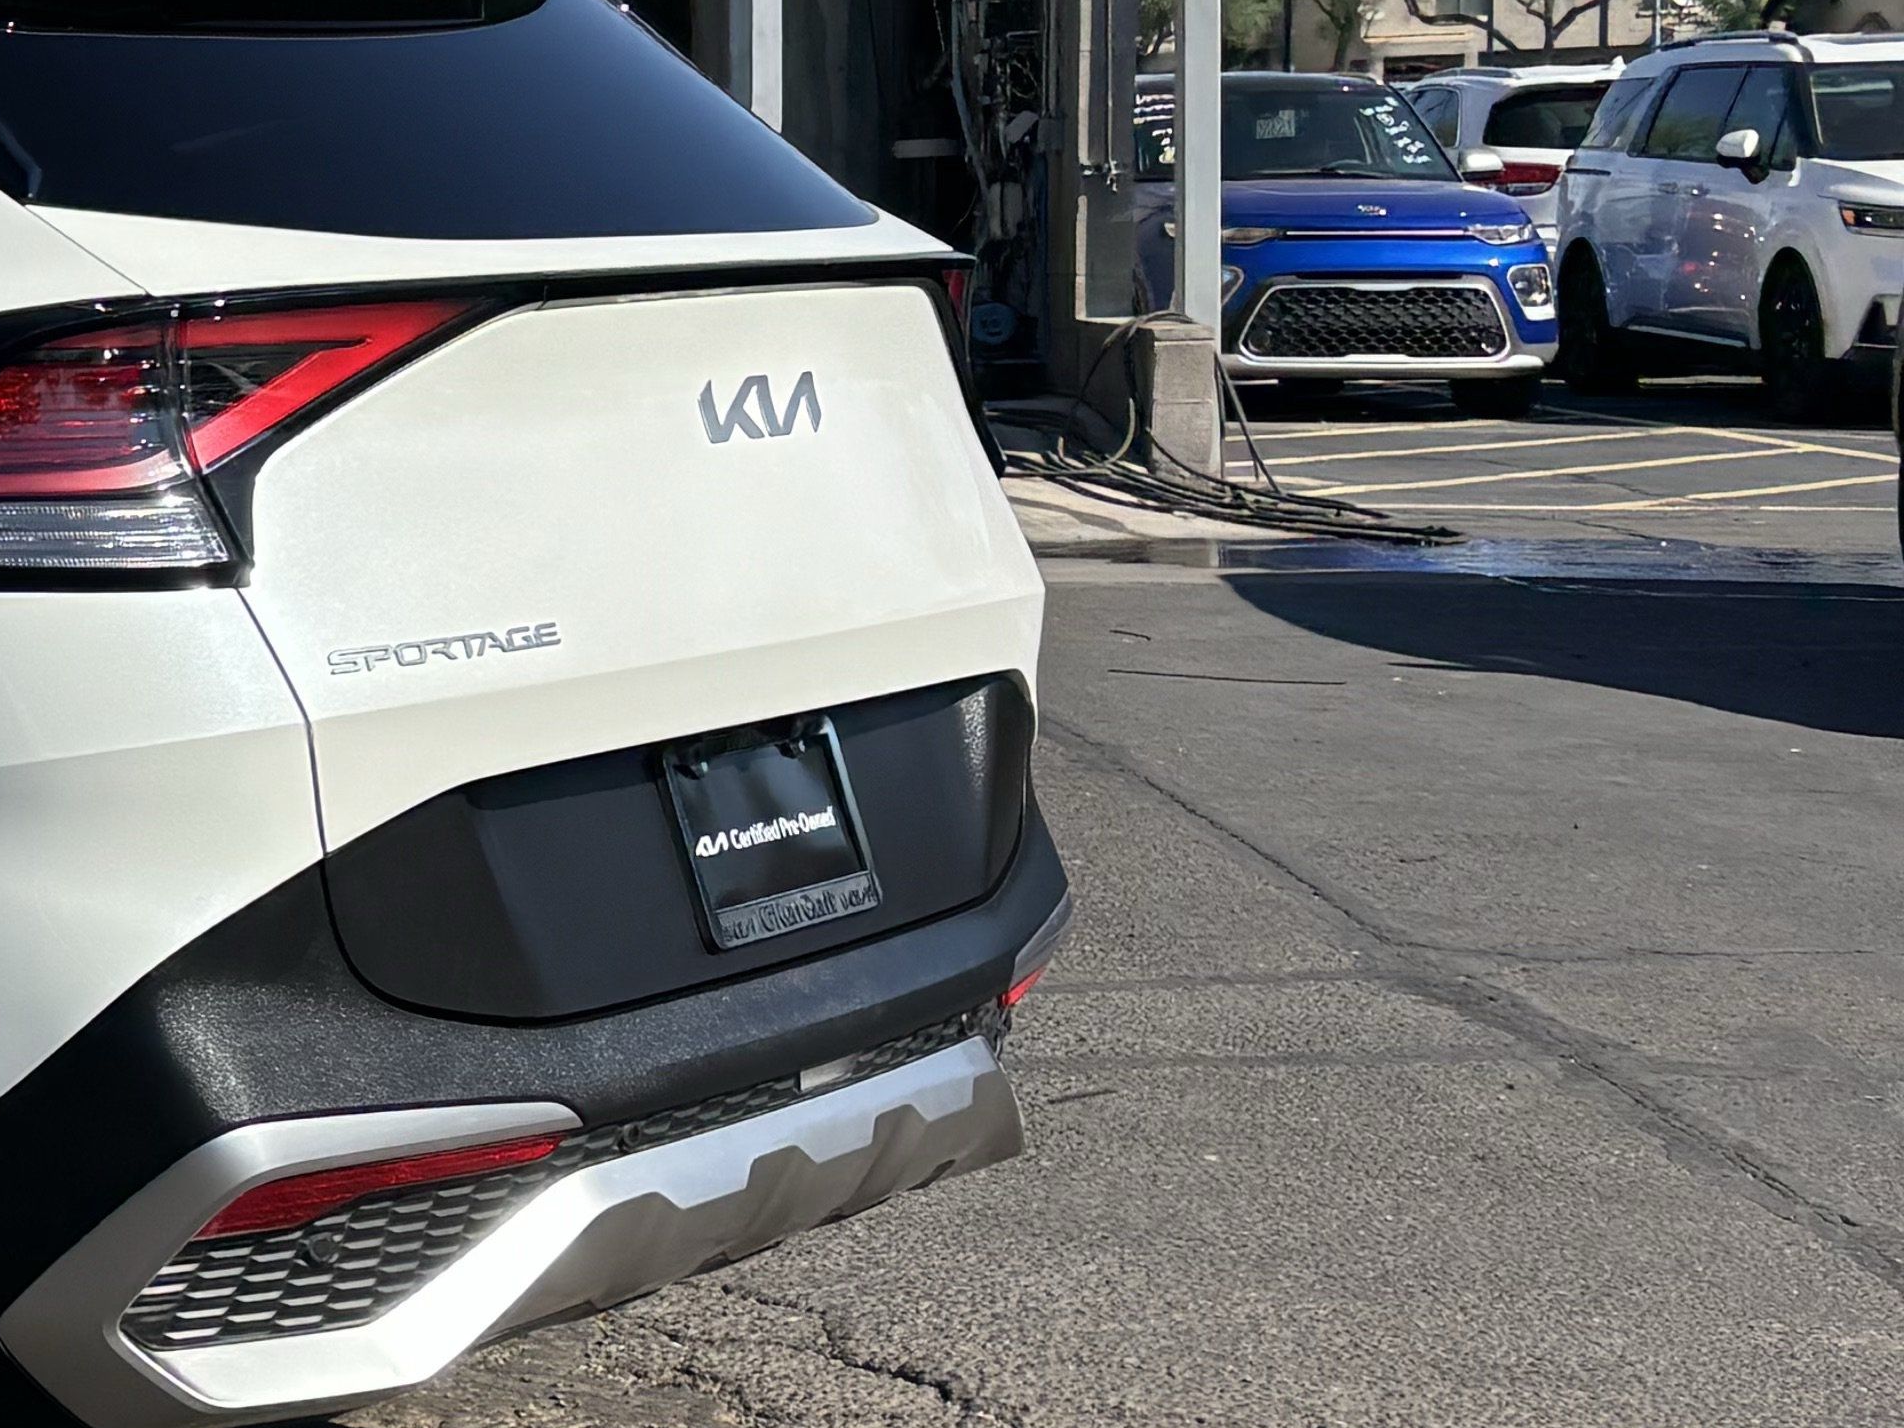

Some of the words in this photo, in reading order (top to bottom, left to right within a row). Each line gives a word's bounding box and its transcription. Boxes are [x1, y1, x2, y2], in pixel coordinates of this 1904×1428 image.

[697, 371, 822, 444] KIA
[327, 622, 562, 675] SPORTAGE
[730, 818, 782, 850] Certified
[778, 805, 837, 839] Pre-Owned
